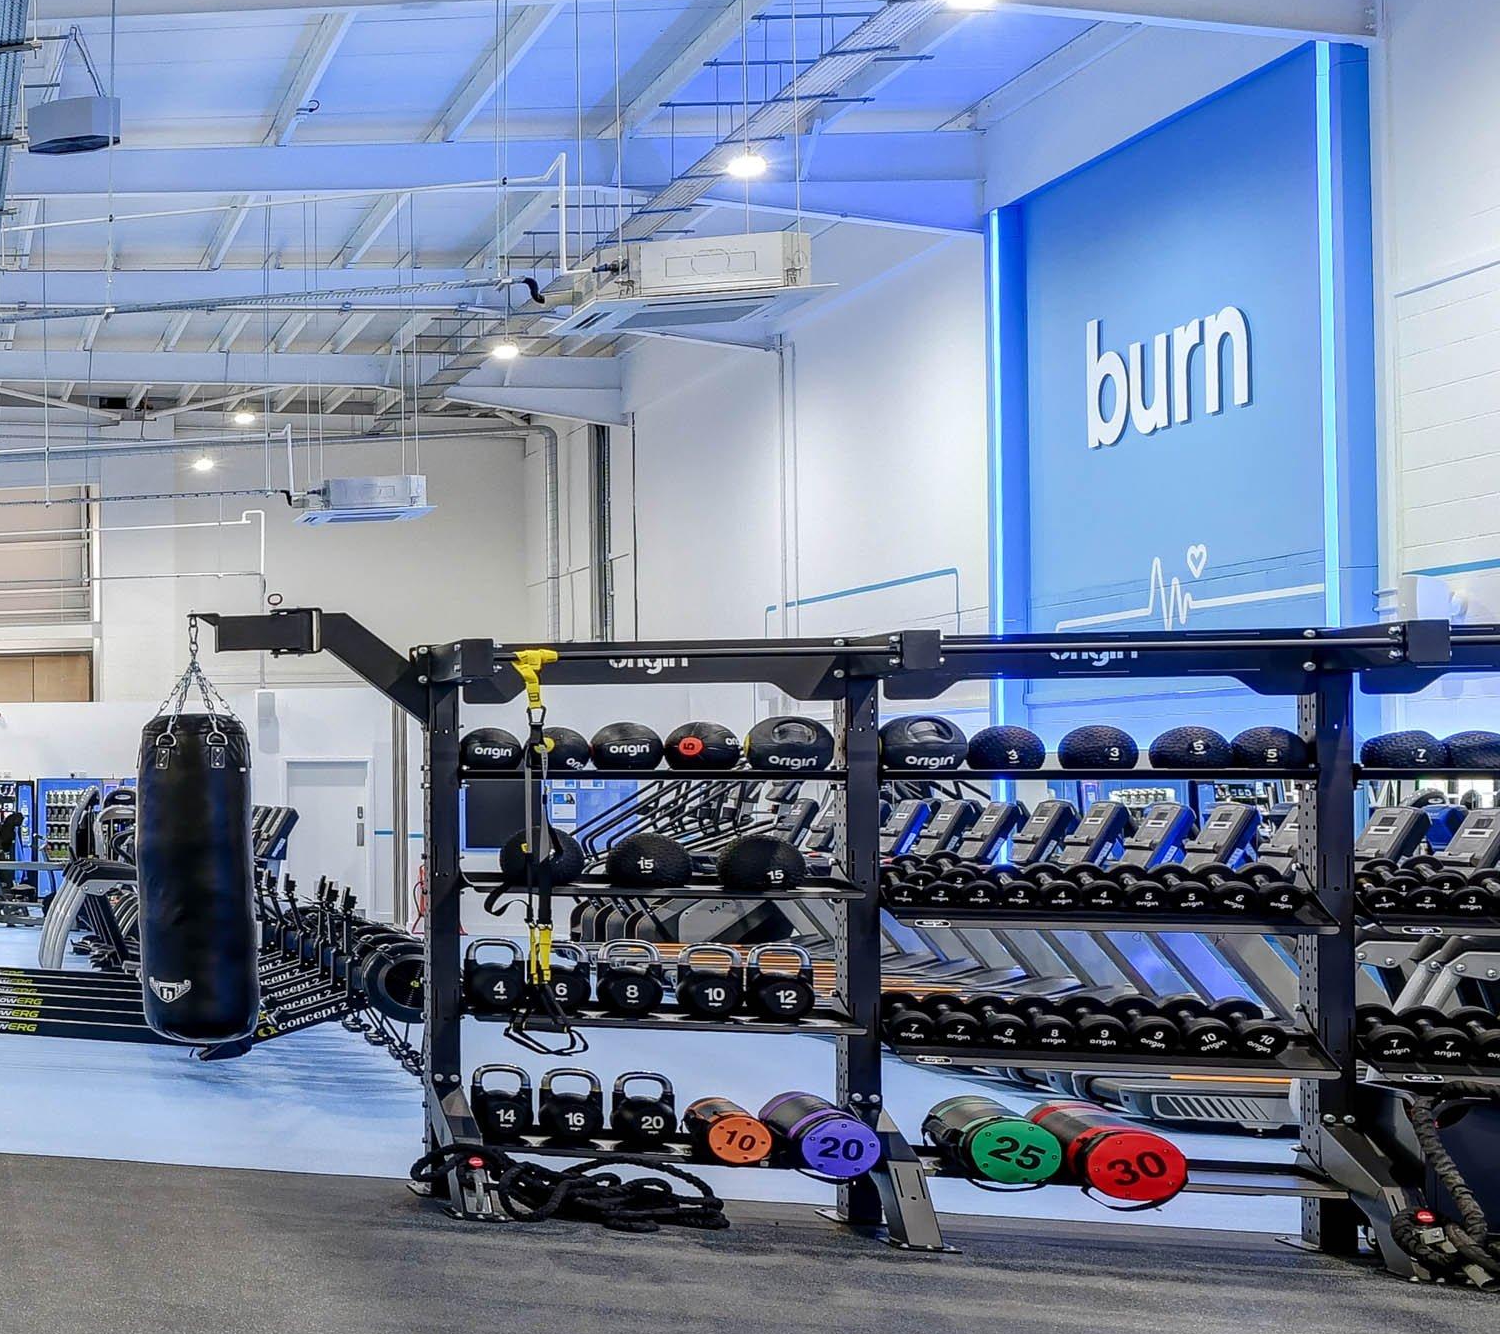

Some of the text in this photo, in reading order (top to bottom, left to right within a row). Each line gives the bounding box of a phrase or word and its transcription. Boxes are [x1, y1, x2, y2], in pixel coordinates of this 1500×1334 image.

[1086, 306, 1250, 449] burn
[474, 746, 512, 759] origin
[610, 743, 651, 757] origin
[1109, 746, 1120, 758] 3
[1192, 740, 1205, 753] 5
[1008, 749, 1019, 761] 3
[1267, 748, 1278, 759] 5
[1417, 748, 1427, 759] 7
[768, 755, 819, 769] origin
[905, 754, 956, 769] origin
[637, 857, 655, 870] 15
[767, 869, 785, 881] 15
[493, 980, 506, 995] 4
[555, 982, 568, 996] 6
[626, 984, 639, 999] 8
[704, 987, 726, 1002] 10
[775, 990, 797, 1004] 12
[278, 1001, 349, 1031] concept 2
[910, 1023, 919, 1032] 7
[956, 1025, 965, 1033] 7
[1004, 1027, 1014, 1037] 8
[1050, 1028, 1060, 1038] 8
[1100, 1029, 1110, 1038] 9
[1153, 1031, 1164, 1040] 9
[1200, 1032, 1218, 1044] 10
[1259, 1034, 1276, 1045] 10
[1089, 1038, 1117, 1047] origin
[1390, 1039, 1399, 1048] 7
[1445, 1040, 1455, 1050] 7
[496, 1109, 517, 1123] 14
[564, 1112, 585, 1127] 16
[641, 1115, 665, 1130] 20
[725, 1129, 756, 1152] 10
[818, 1136, 865, 1161] 20
[987, 1135, 1047, 1170] 25
[1106, 1151, 1168, 1186] 30
